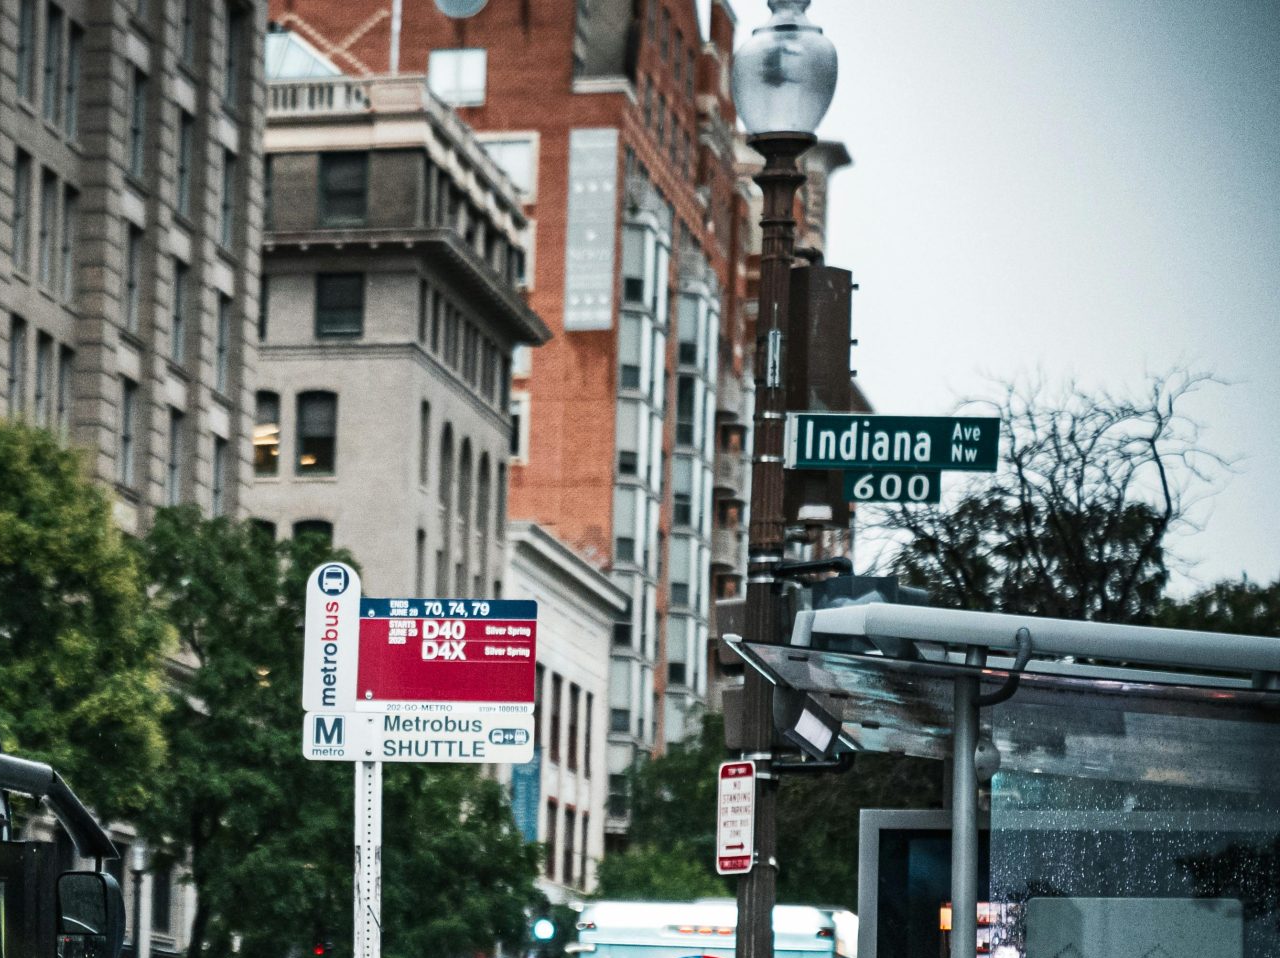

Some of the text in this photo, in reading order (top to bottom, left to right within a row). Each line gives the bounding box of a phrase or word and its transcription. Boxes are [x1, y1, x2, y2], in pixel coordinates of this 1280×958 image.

[805, 419, 932, 462] Indiana
[952, 422, 981, 442] Ave
[853, 473, 930, 500] 600
[390, 608, 408, 616] JUNE
[424, 602, 490, 617] 70, 74, 79
[389, 620, 416, 628] STARTS
[389, 628, 407, 636] JUNE
[422, 621, 466, 640] D40
[485, 626, 531, 637] Silver Spring
[320, 601, 339, 707] metrobus
[422, 641, 466, 660] D4X
[485, 646, 531, 657] Silver Spring
[315, 717, 343, 745] M
[383, 715, 483, 732] Metrobus
[311, 747, 345, 757] metro
[383, 739, 486, 758] SHUTTLE
